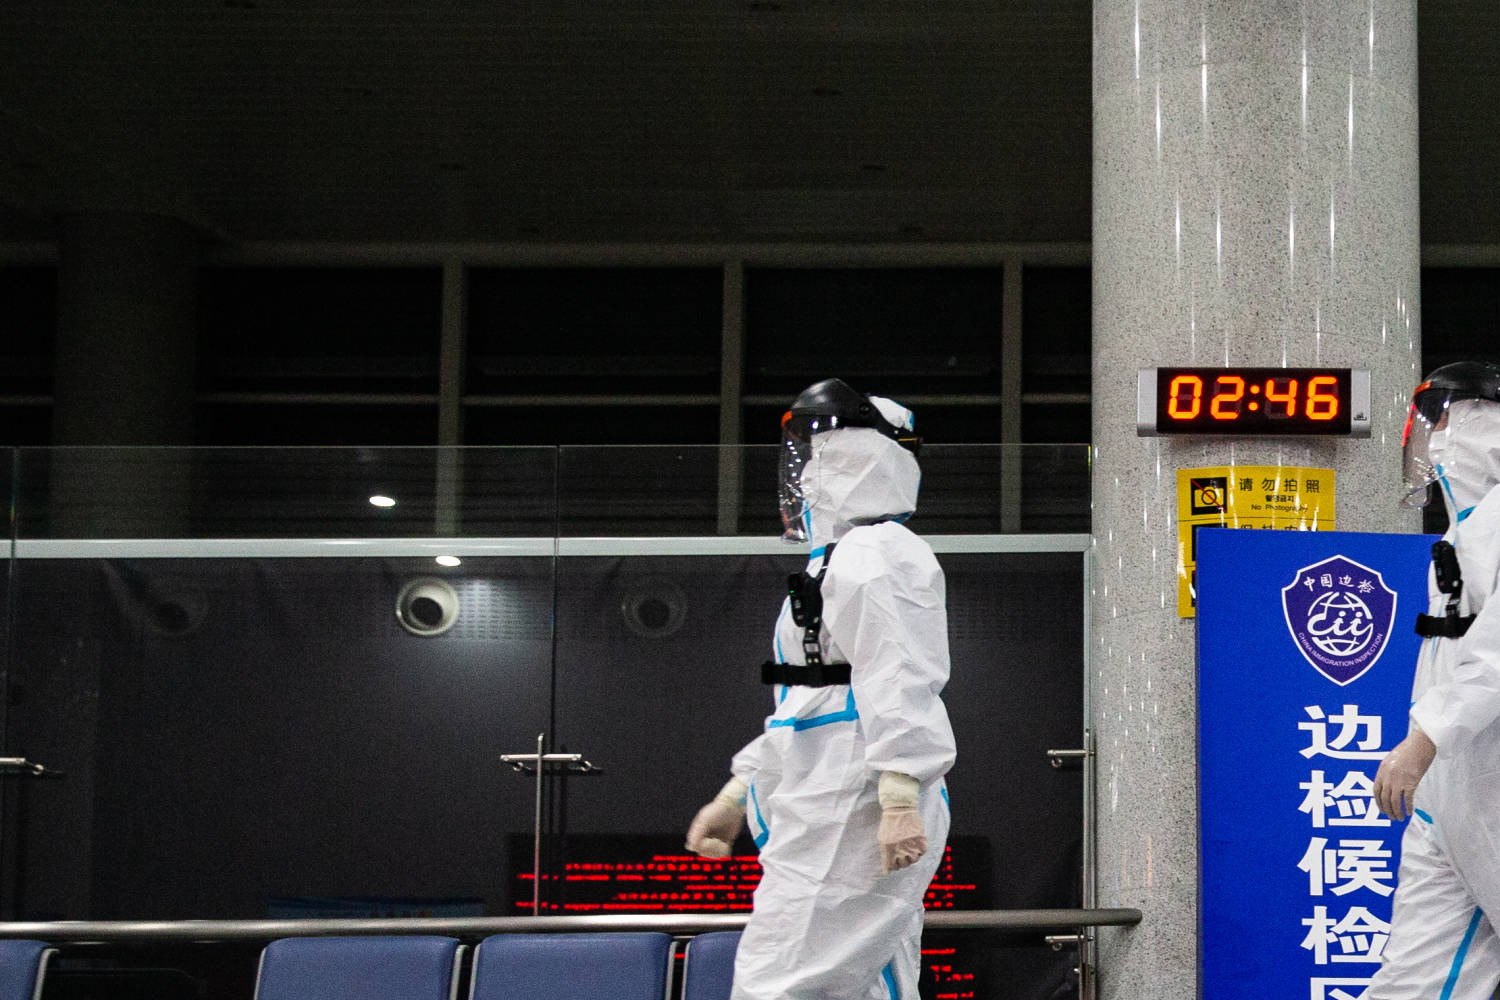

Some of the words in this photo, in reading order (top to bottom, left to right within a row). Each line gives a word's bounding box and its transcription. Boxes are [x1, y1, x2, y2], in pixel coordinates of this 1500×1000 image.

[1167, 375, 1341, 420] 02:46
[1239, 478, 1320, 493] 请勿拍照
[1265, 504, 1308, 512] Photograhy
[1303, 573, 1375, 594] 中国边检
[1311, 649, 1355, 667] IMMIGRATION
[1354, 632, 1384, 664] INSPECTION
